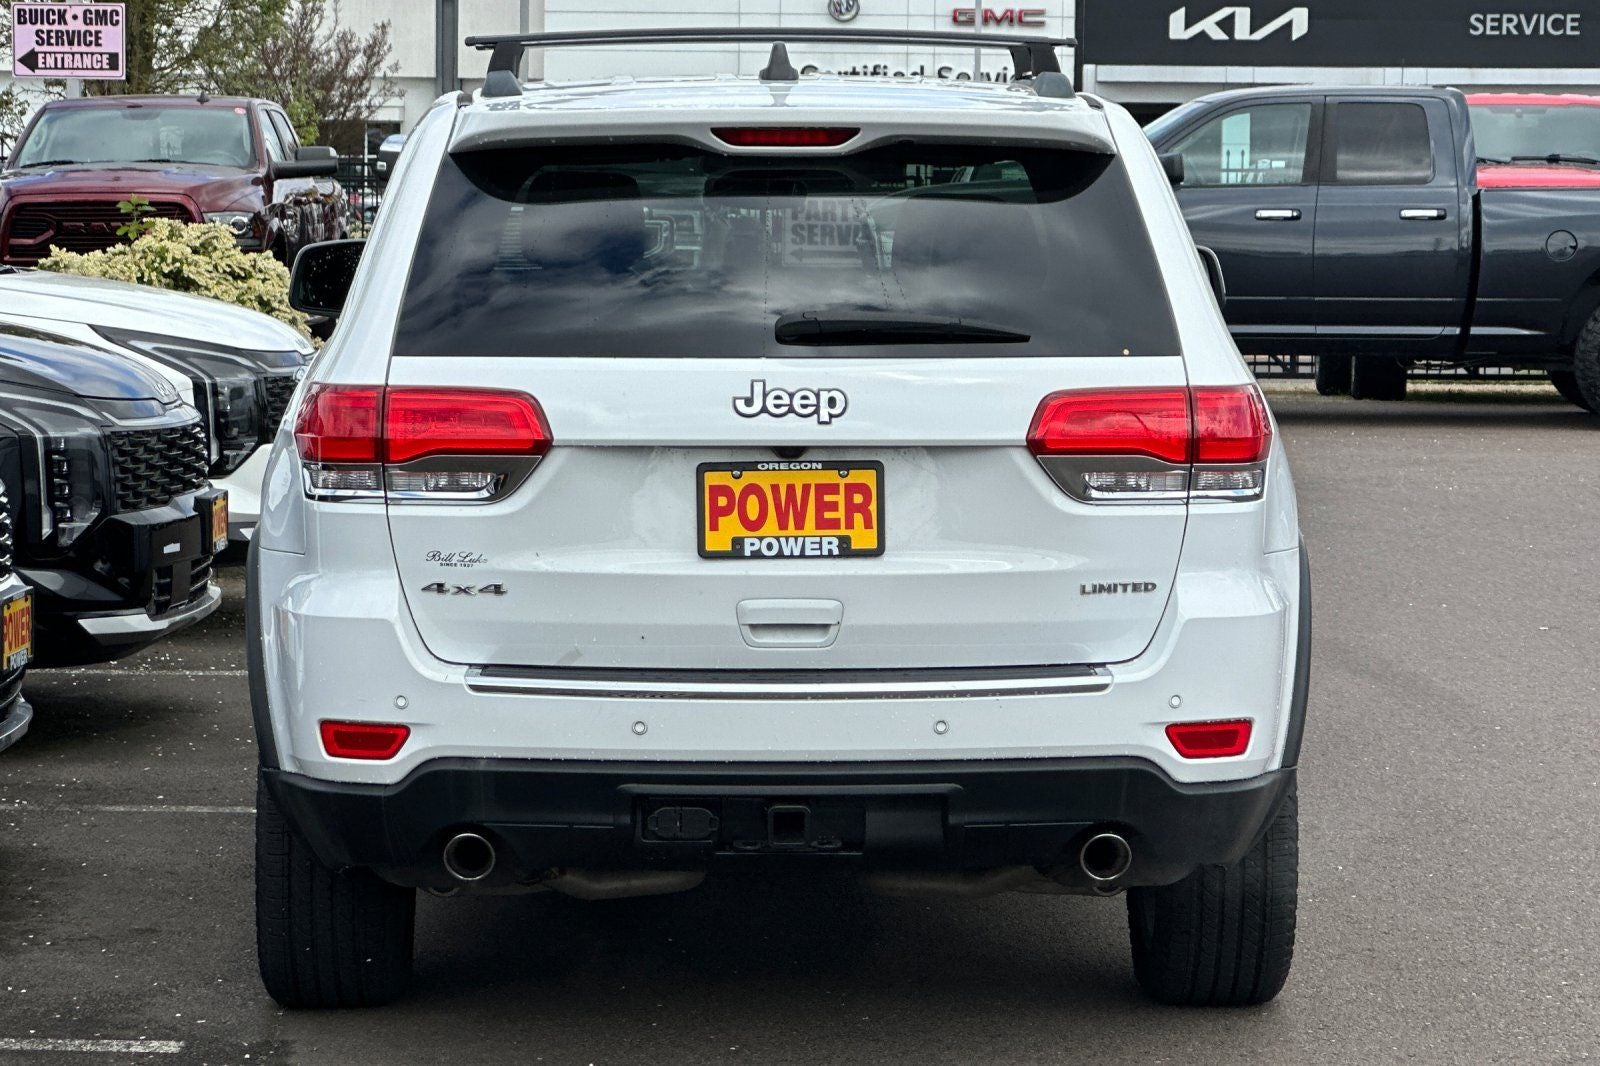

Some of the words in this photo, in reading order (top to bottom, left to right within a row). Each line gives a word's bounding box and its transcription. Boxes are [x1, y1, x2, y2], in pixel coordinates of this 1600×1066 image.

[16, 8, 68, 26] BUICK
[82, 9, 120, 26] GMC
[952, 8, 1046, 26] GMC
[1169, 7, 1309, 41] KIA
[1469, 13, 1581, 36] SERVICE
[35, 29, 103, 47] SERVICE
[37, 52, 110, 69] ENTRANCE
[799, 64, 925, 76] Ctifid
[732, 379, 848, 425] Jeep
[757, 462, 823, 470] OREGON
[708, 482, 874, 532] POWER
[743, 536, 840, 557] POWER
[425, 550, 457, 563] Bill
[1080, 582, 1157, 595] LIMITED
[3, 606, 32, 652] POWER
